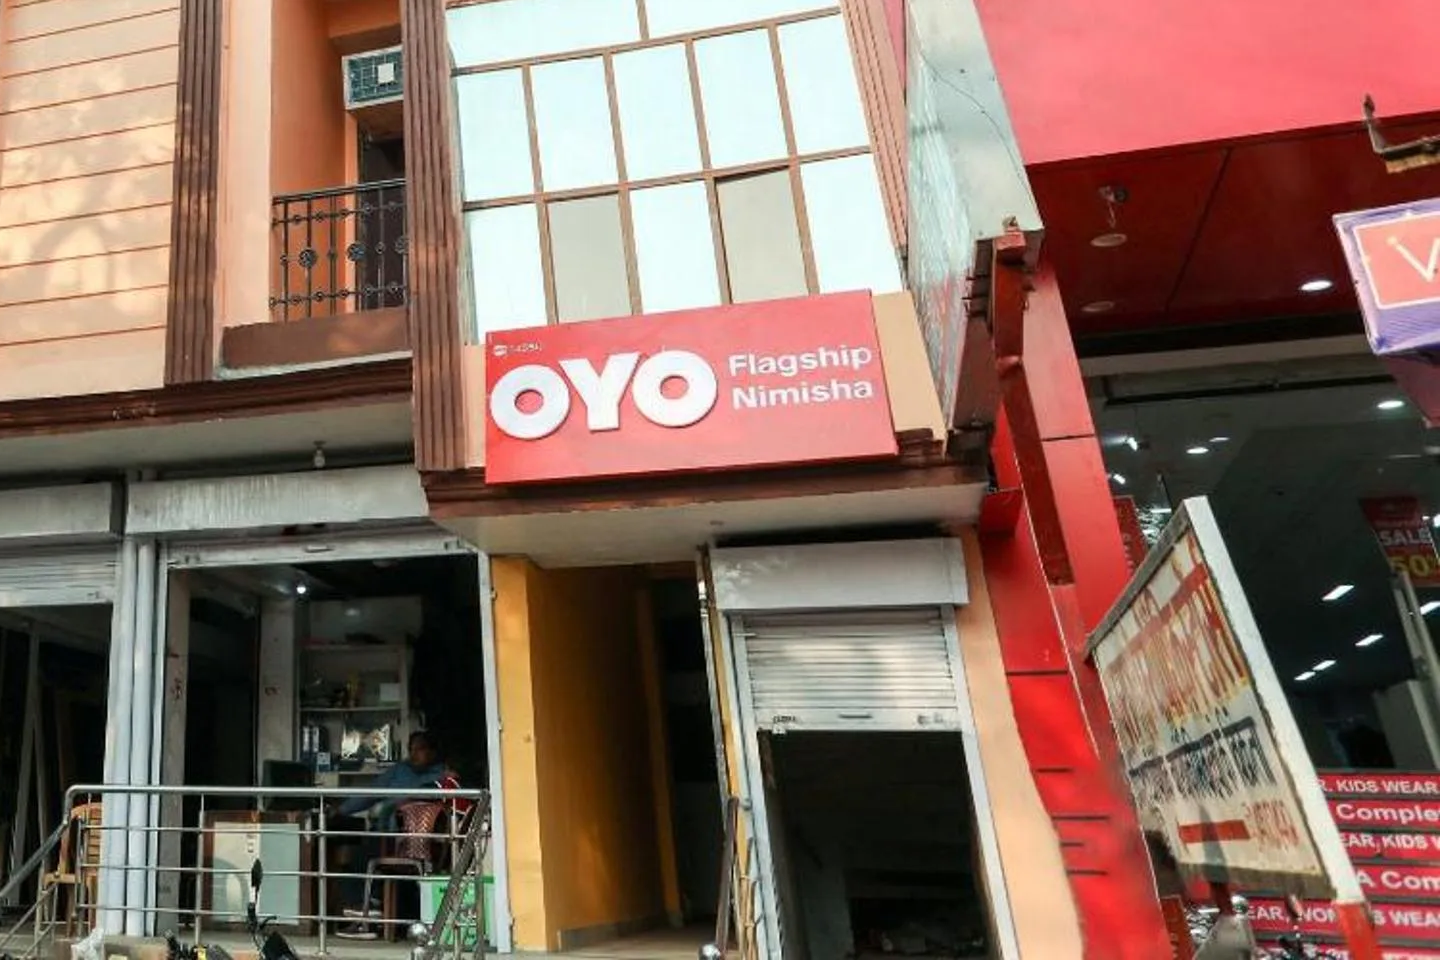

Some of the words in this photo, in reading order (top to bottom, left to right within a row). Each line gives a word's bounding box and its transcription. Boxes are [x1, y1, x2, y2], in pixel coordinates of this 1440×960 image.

[728, 344, 873, 378] Flagship
[490, 349, 719, 440] OYO
[732, 379, 874, 410] Nimisha
[1379, 528, 1433, 547] SALE
[1336, 779, 1378, 793] KIDS
[1336, 803, 1440, 825] Comple
[1382, 834, 1428, 851] KIDS
